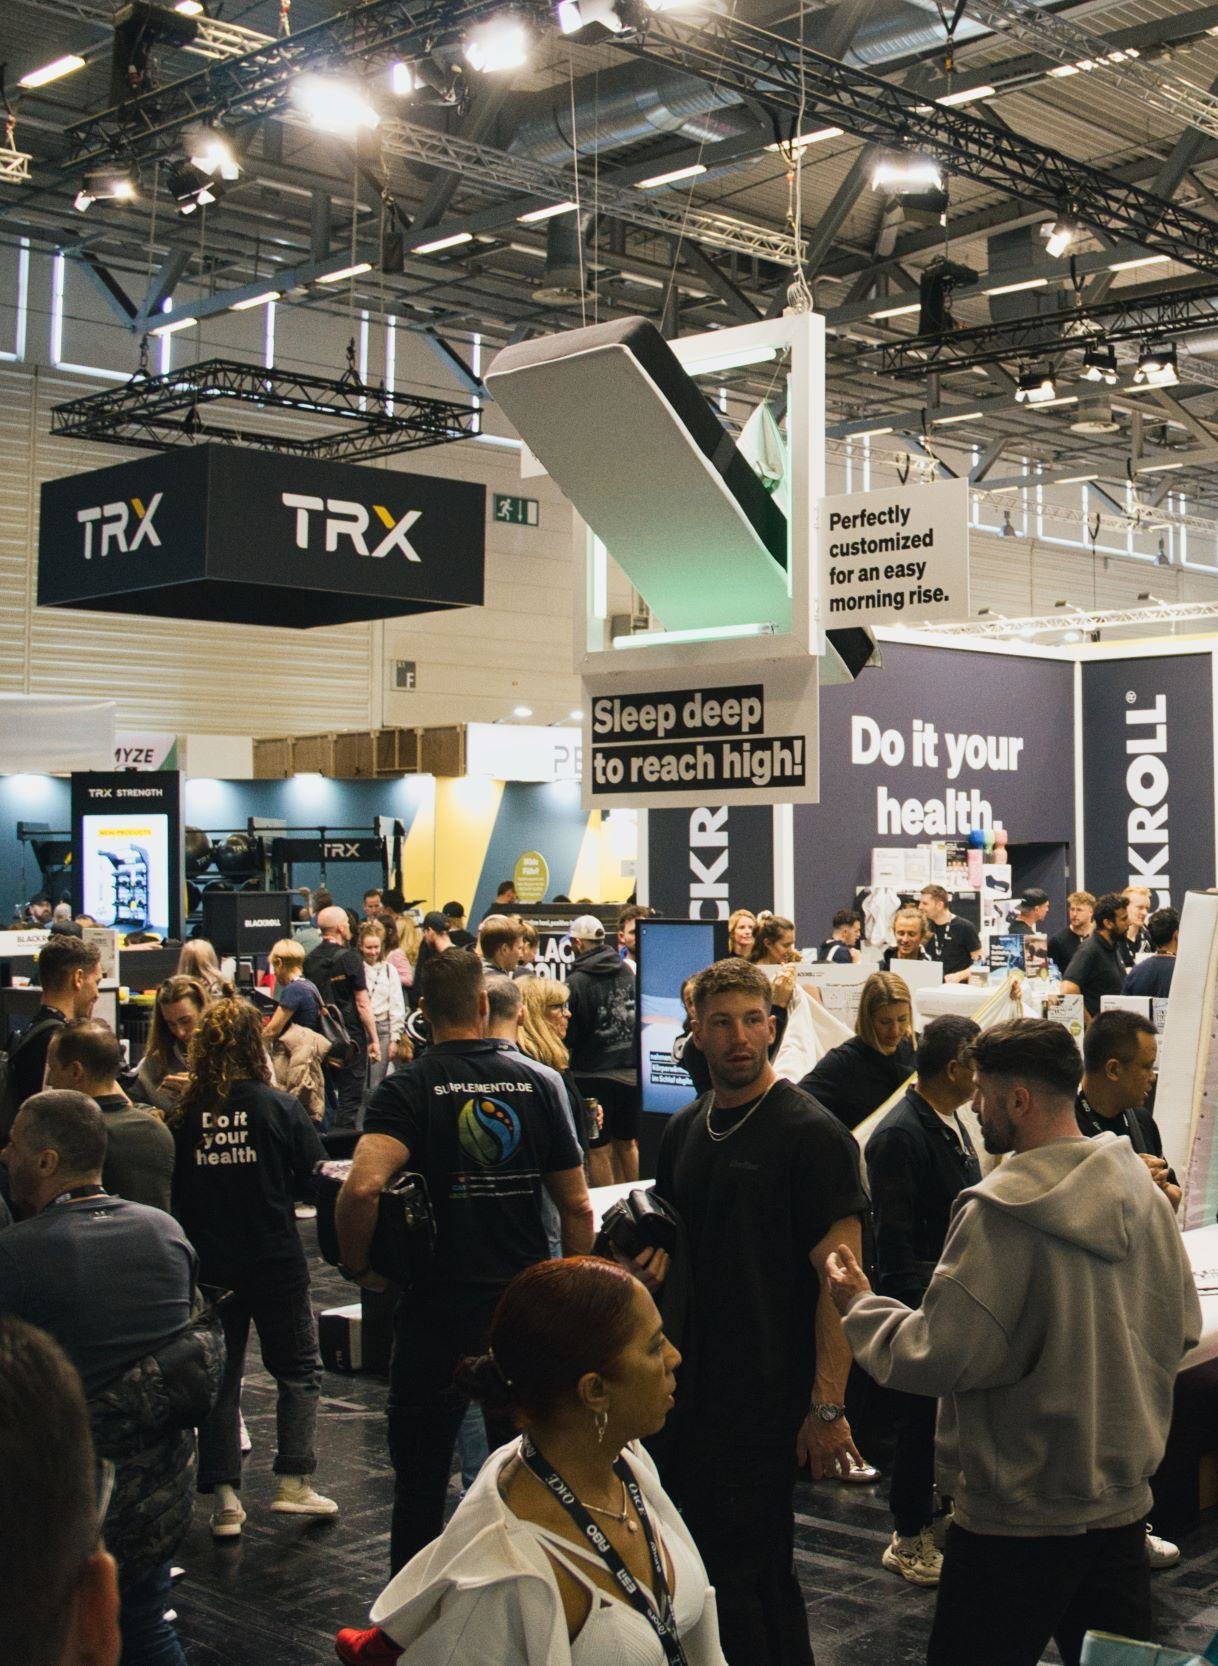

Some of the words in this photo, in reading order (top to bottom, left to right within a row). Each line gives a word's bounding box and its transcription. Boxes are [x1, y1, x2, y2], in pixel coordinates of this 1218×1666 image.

[77, 492, 164, 560] TRX
[282, 492, 423, 563] TRX
[830, 505, 911, 531] Perfectly
[830, 528, 934, 558] customized
[830, 566, 855, 585] for
[858, 566, 880, 582] an
[884, 561, 927, 580] easy
[830, 589, 905, 612] morning
[909, 585, 950, 605] rise.
[593, 698, 677, 738] Sleep
[682, 692, 762, 732] deep
[851, 715, 905, 767] Do
[912, 719, 938, 768] it
[945, 733, 1024, 779] your
[593, 752, 624, 784] to
[630, 745, 716, 783] reach
[723, 739, 803, 786] high!
[88, 788, 113, 798] TRX
[116, 788, 163, 797] STRENGTH
[877, 786, 1003, 836] health.
[318, 843, 360, 858] TRX
[234, 1111, 248, 1126] it
[202, 1131, 248, 1149] your
[196, 1146, 257, 1165] health
[586, 1523, 611, 1553] FIBO
